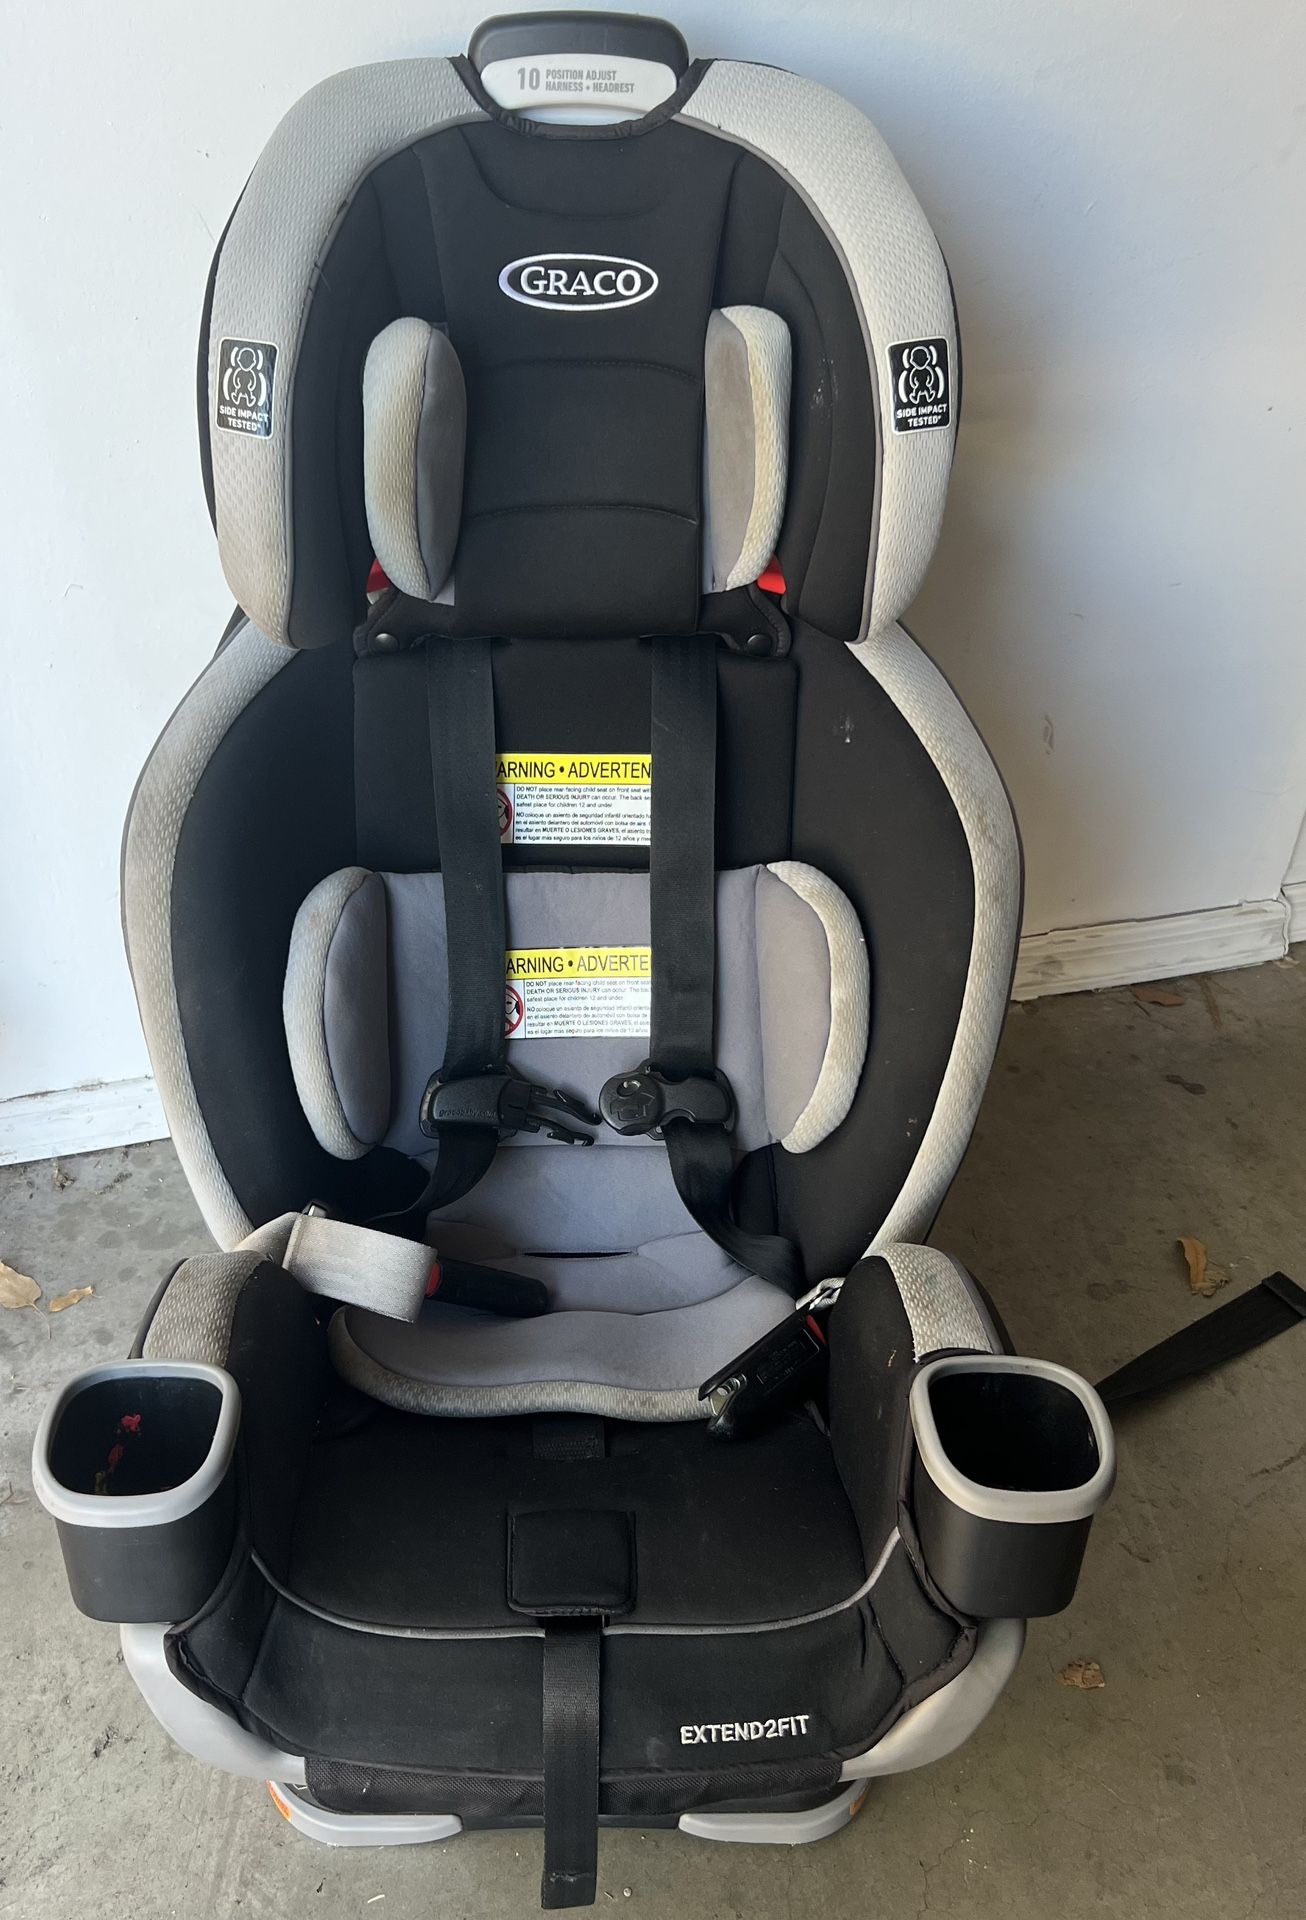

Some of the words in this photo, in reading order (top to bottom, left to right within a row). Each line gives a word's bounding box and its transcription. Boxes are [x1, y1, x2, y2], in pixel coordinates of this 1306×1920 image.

[517, 67, 541, 91] 10
[545, 69, 583, 80] POSITION
[586, 70, 616, 81] ADJUST
[545, 82, 583, 92] HARNESS
[592, 83, 635, 94] HEADREST
[520, 266, 642, 296] GRACO
[219, 405, 236, 416] SIDE
[238, 409, 268, 422] IMPACT
[896, 407, 917, 418] SIDE
[918, 404, 947, 415] IMPACT
[496, 762, 555, 778] ARNING
[680, 1714, 810, 1744] EXTEND2FIT
